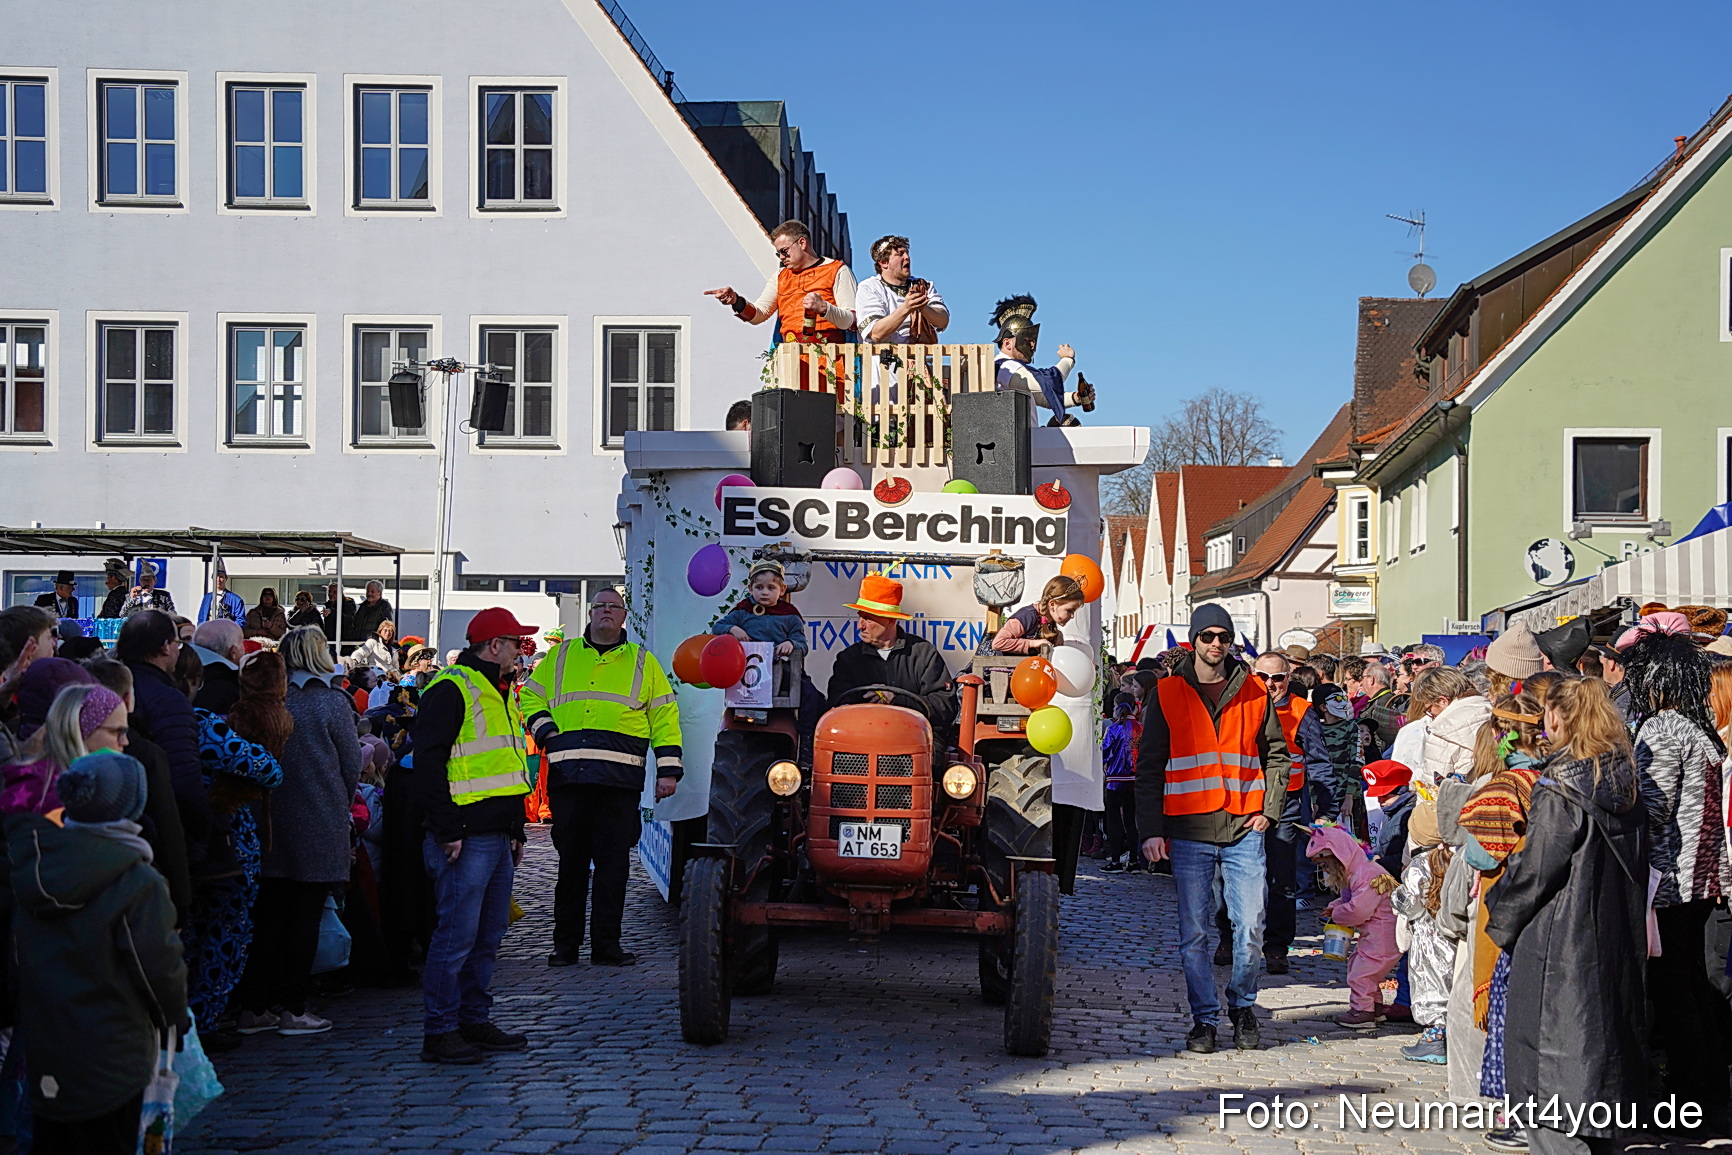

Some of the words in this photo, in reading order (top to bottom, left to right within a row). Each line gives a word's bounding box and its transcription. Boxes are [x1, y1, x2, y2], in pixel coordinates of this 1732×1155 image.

[723, 496, 830, 538] ESC
[835, 501, 1067, 556] Berching
[740, 653, 764, 689] 6
[857, 826, 882, 841] NM
[842, 841, 864, 856] AT
[870, 842, 898, 857] 653
